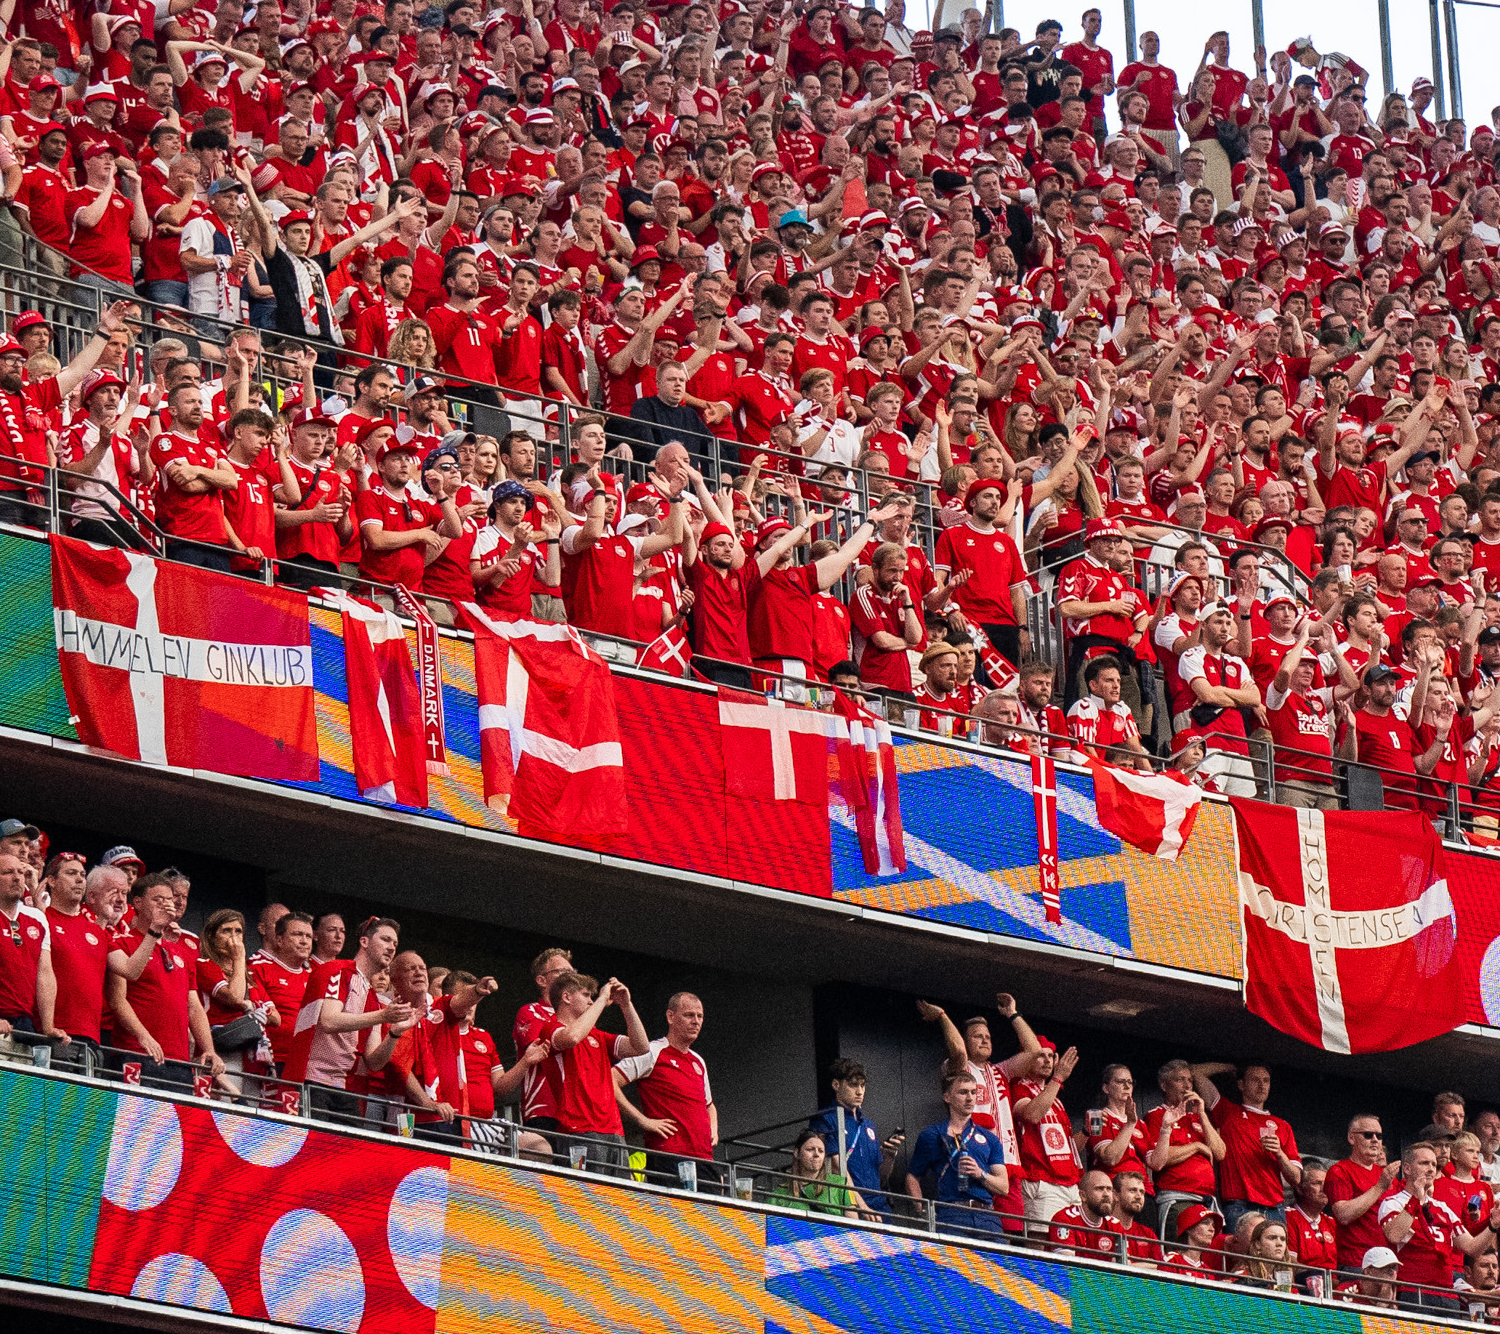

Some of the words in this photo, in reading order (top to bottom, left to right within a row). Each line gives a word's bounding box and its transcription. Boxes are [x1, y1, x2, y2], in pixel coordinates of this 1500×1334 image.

[248, 482, 264, 504] 15
[206, 641, 306, 687] GINKLUB
[423, 642, 438, 728] DANMARK
